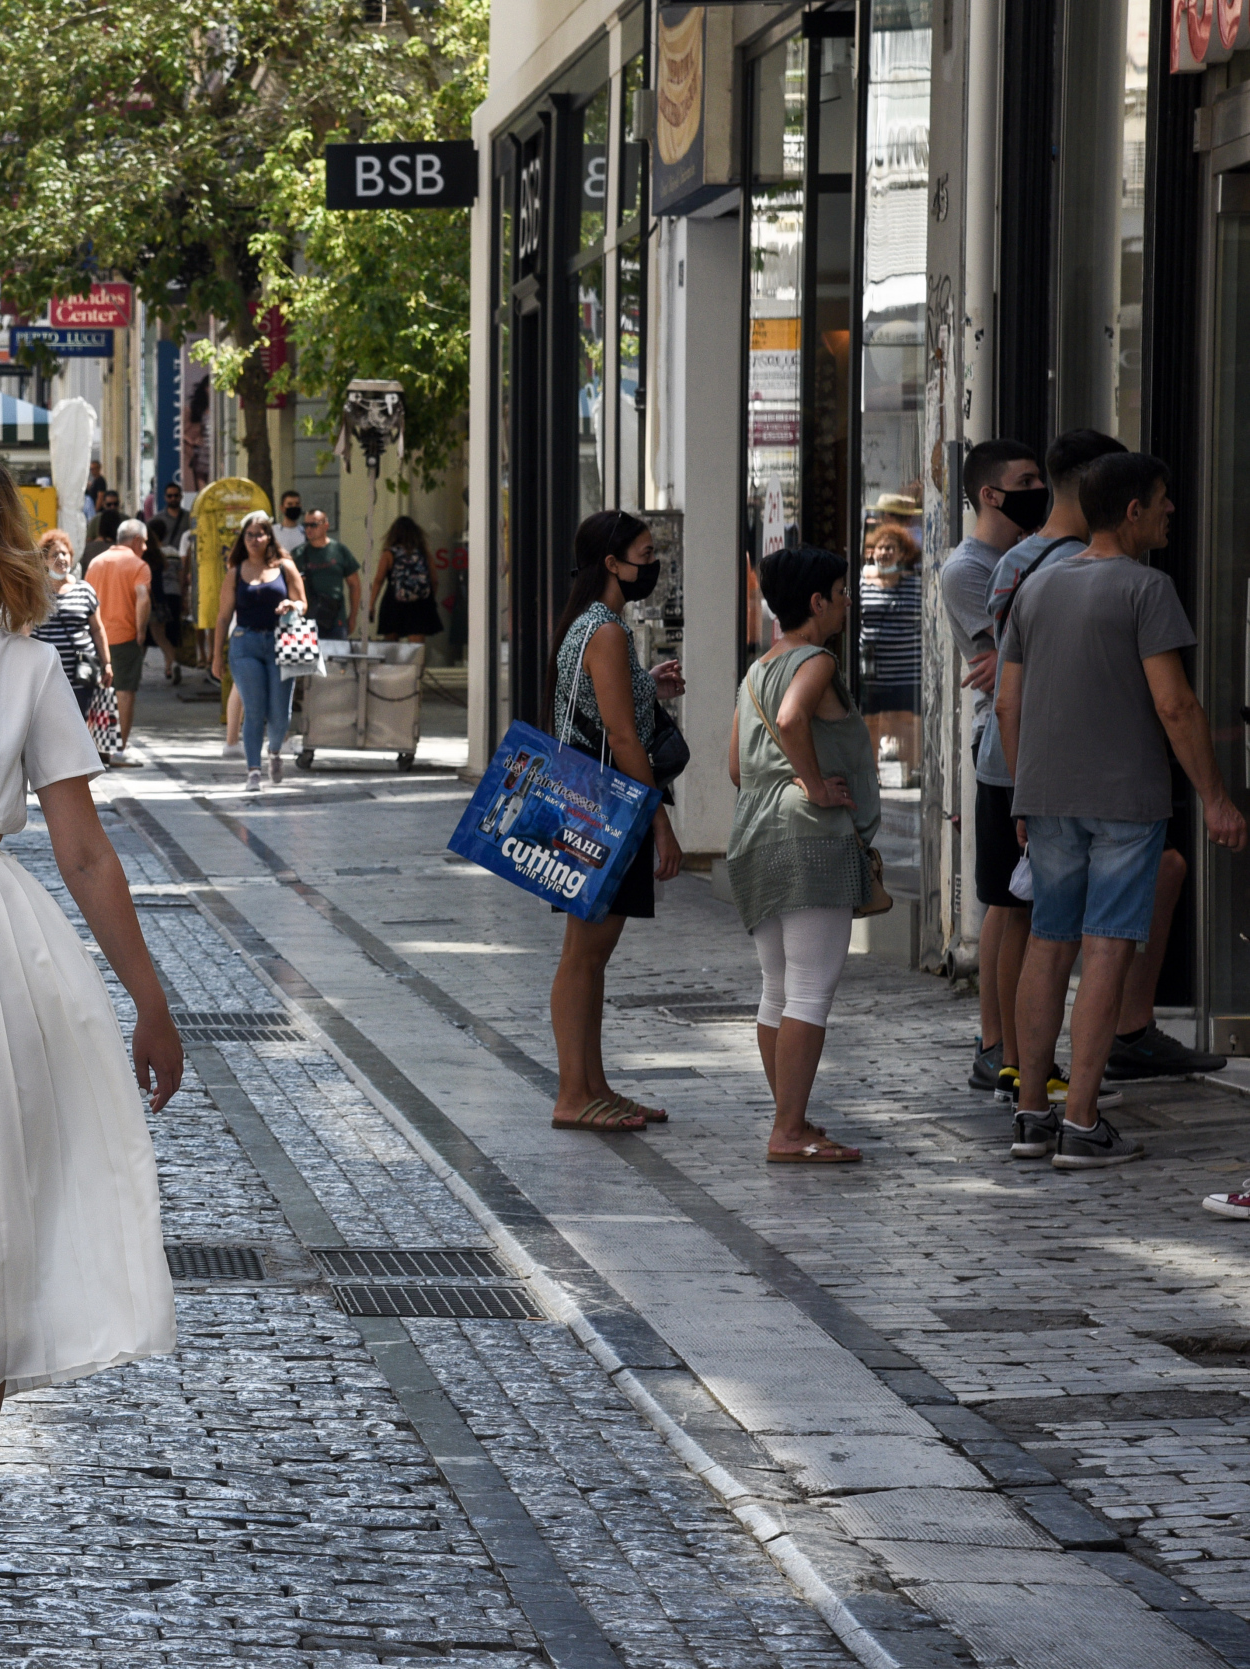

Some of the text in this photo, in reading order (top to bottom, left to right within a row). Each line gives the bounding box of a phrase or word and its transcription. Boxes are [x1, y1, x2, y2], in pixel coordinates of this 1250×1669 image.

[355, 154, 445, 197] BSB
[56, 305, 118, 323] Center
[67, 332, 106, 345] LUCCI
[503, 754, 528, 776] hey
[562, 828, 603, 861] WAHL
[501, 836, 587, 898] cutting
[514, 863, 563, 893] with style
